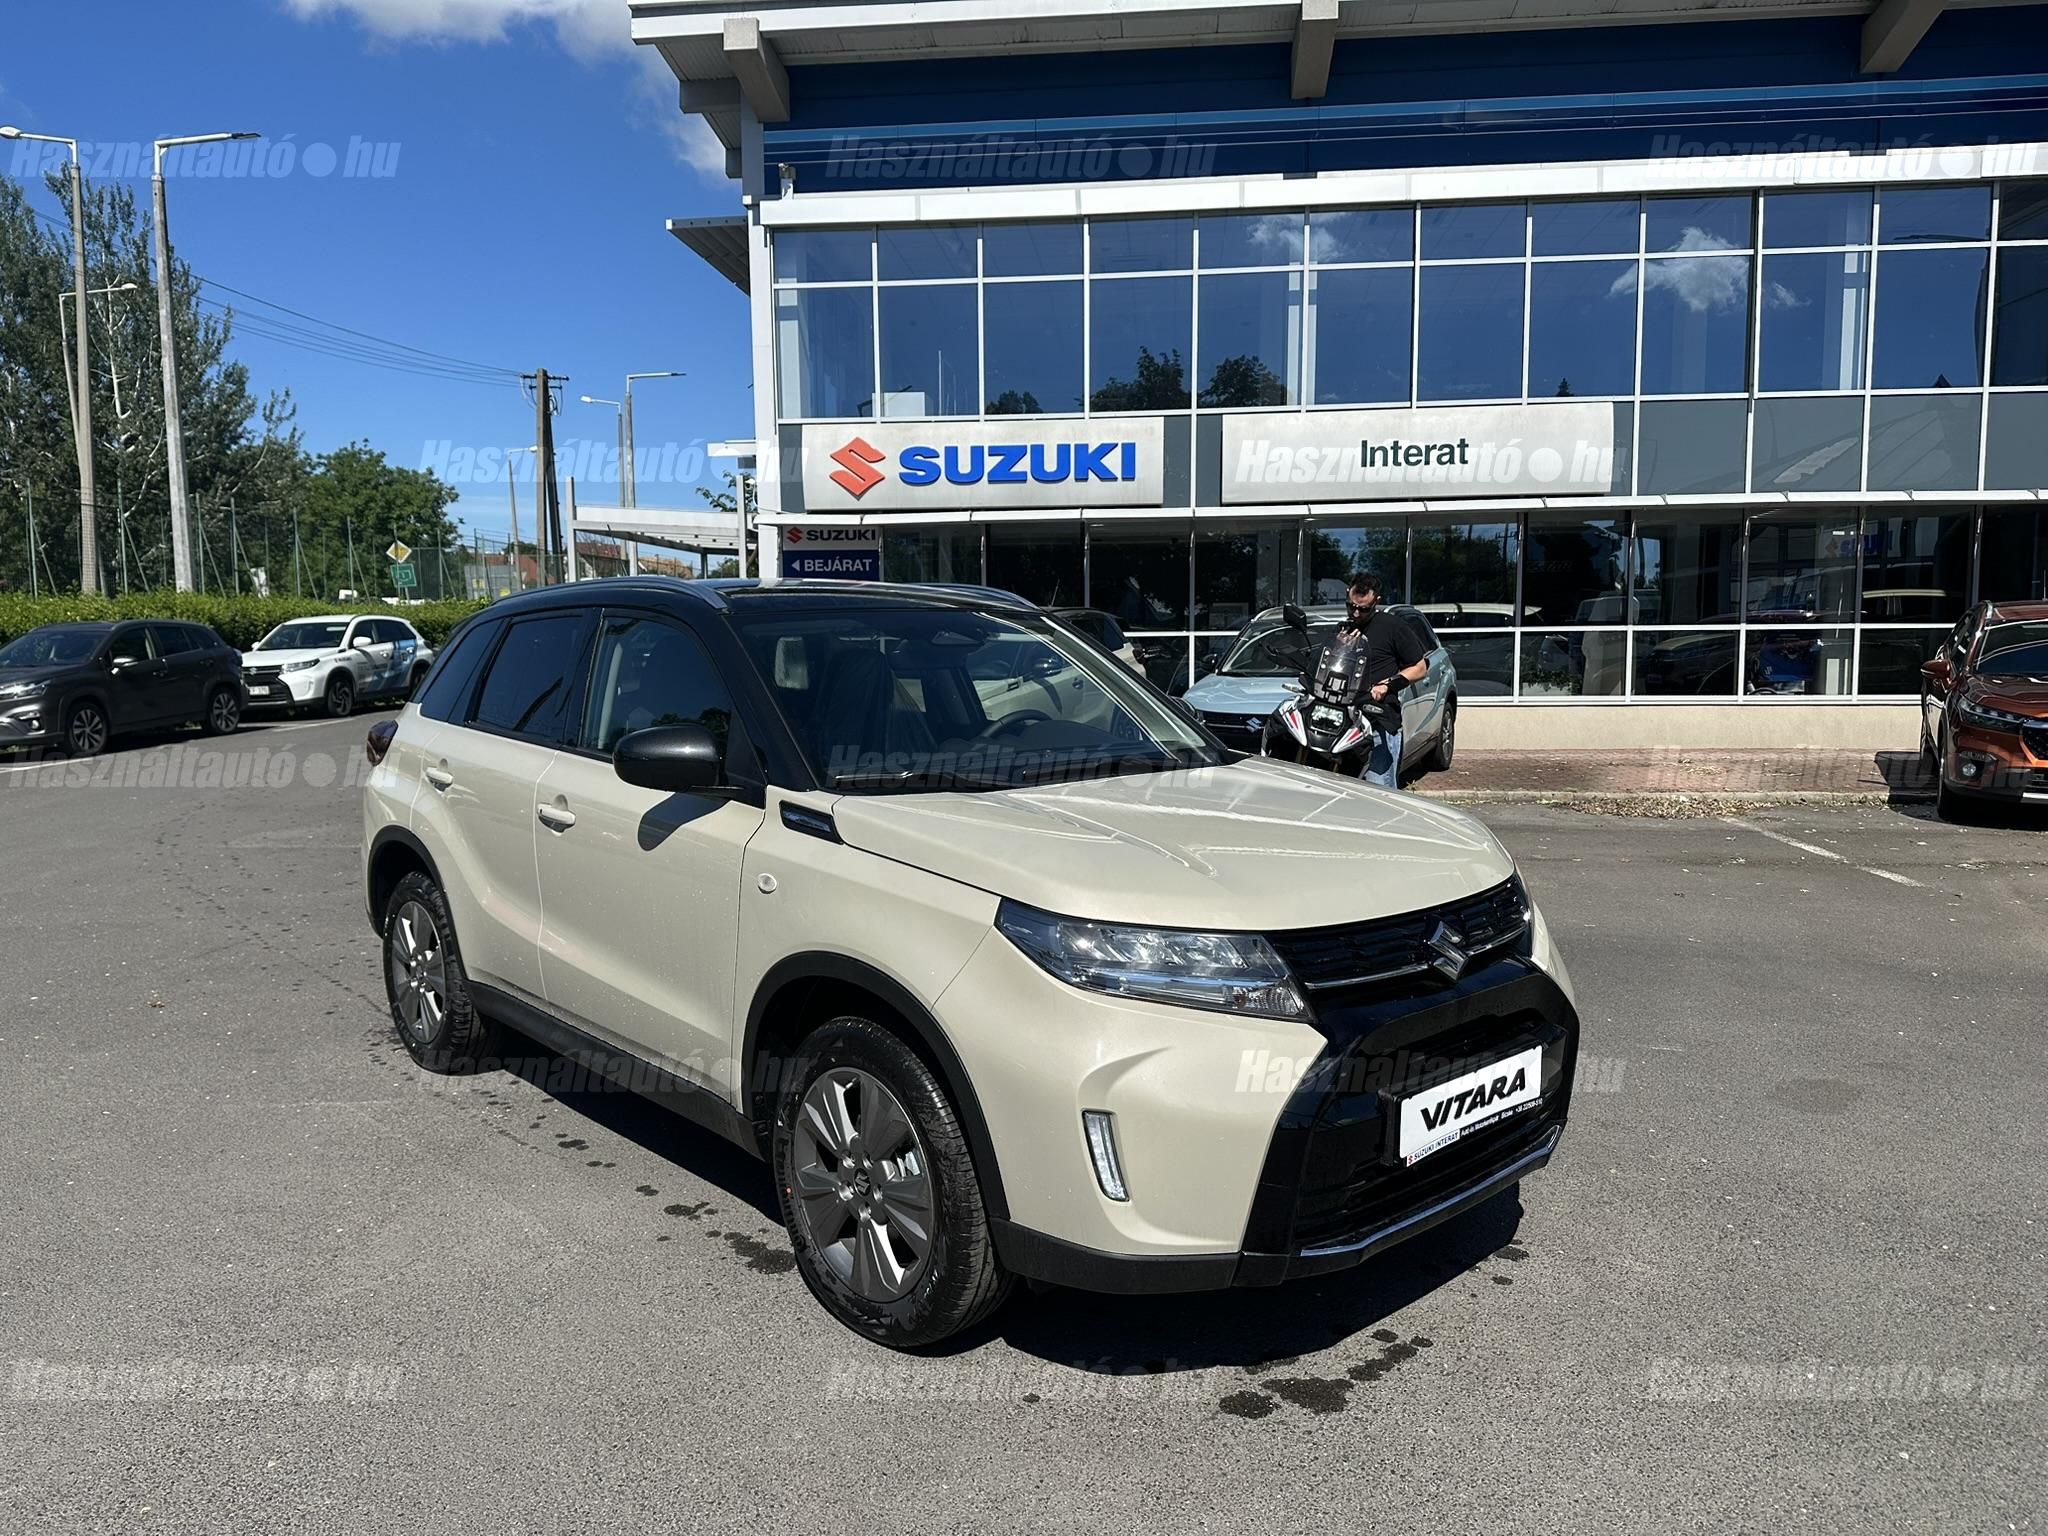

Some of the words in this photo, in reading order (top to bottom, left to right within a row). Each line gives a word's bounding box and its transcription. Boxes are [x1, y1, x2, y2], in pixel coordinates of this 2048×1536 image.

[899, 442, 1136, 486] SUZUKI
[1360, 437, 1469, 468] Interat
[806, 529, 876, 541] SUZUKI
[804, 556, 872, 572] BEJÁRAT
[1421, 1068, 1526, 1132] VITARA
[1413, 1145, 1435, 1161] SUZUKI
[1435, 1132, 1459, 1149] INTERAT
